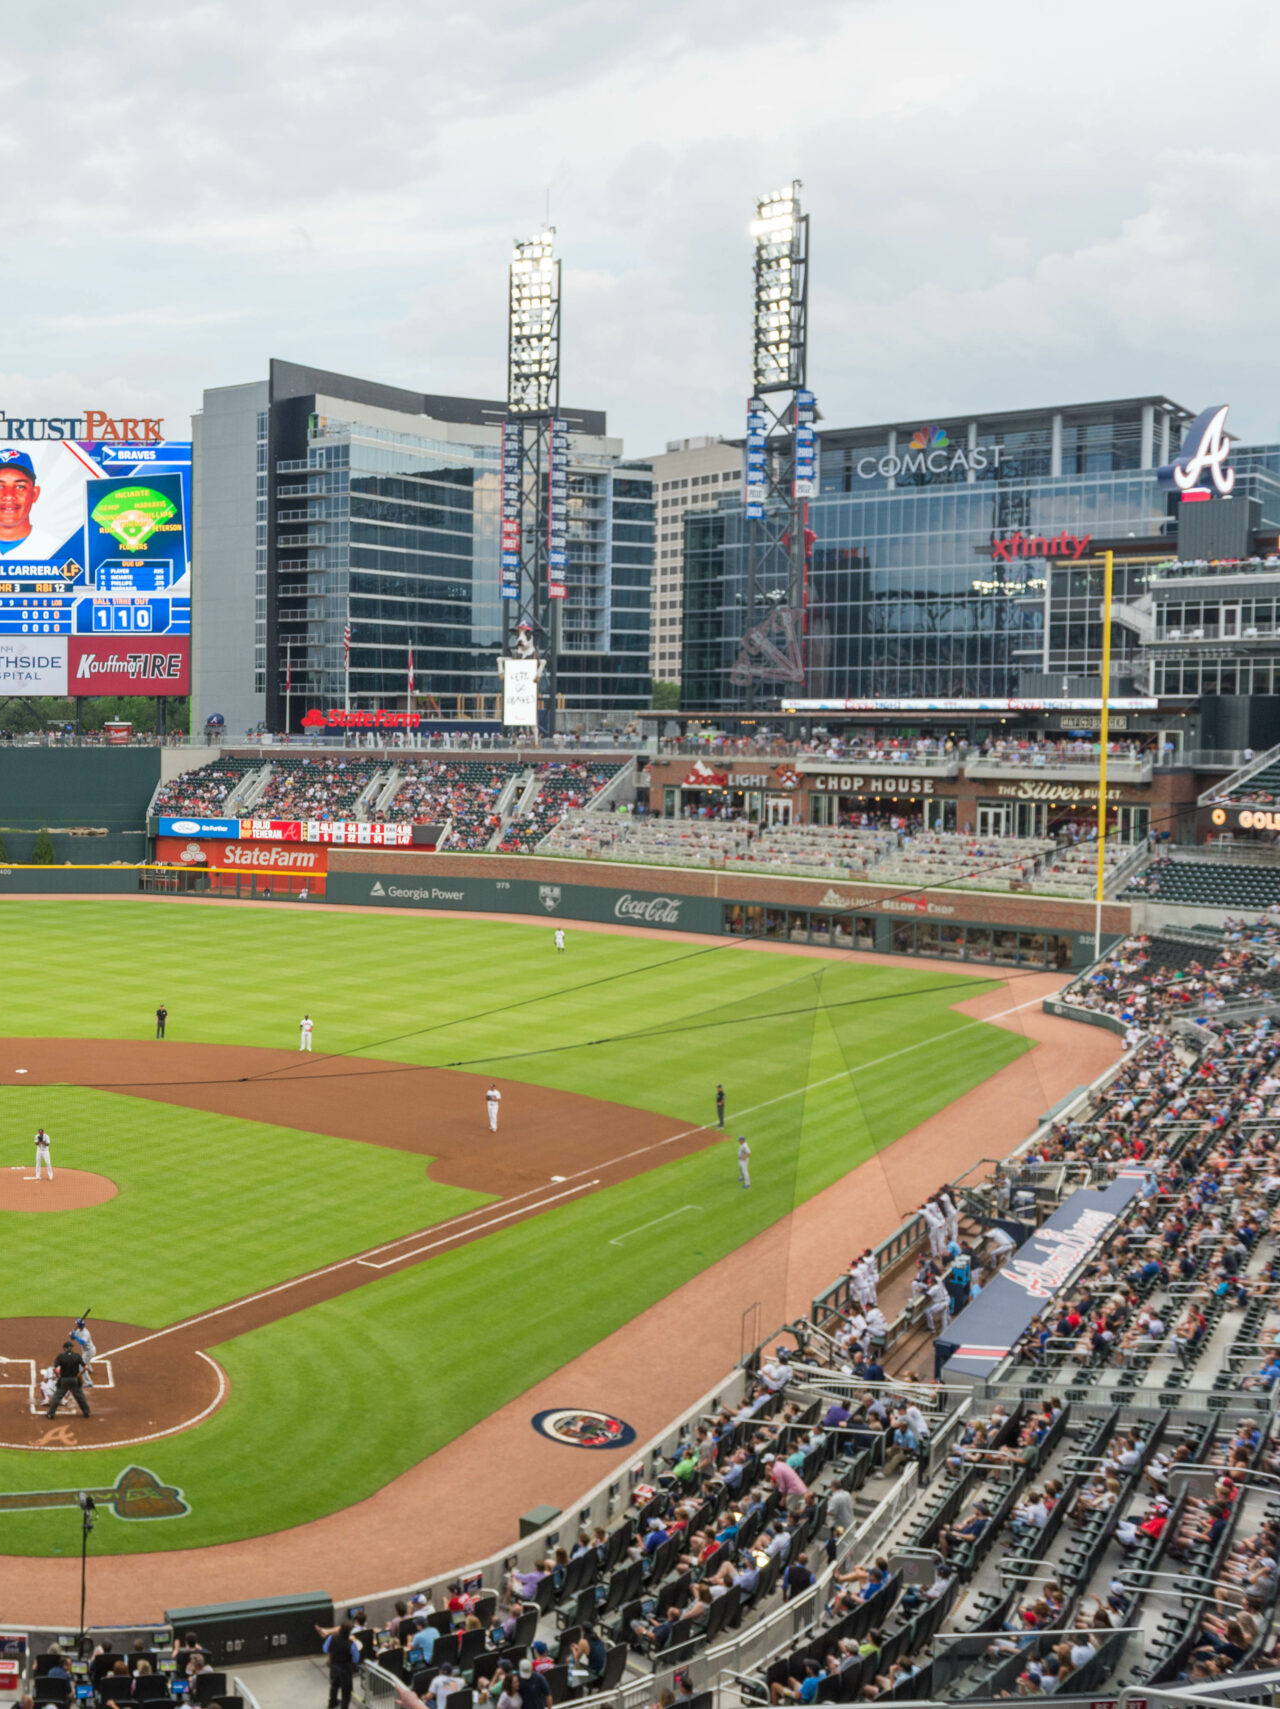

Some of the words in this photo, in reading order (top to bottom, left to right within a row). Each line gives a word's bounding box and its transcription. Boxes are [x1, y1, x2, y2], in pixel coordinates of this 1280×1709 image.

[118, 450, 156, 460] BRAVES
[856, 446, 1005, 479] COMCAST
[992, 531, 1092, 562] xfinity
[8, 565, 58, 576] CARRERA
[63, 564, 79, 576] LF
[14, 584, 20, 592] 3
[36, 584, 52, 592] RBI
[54, 584, 65, 592] 12
[97, 610, 107, 627] 1
[118, 610, 127, 627] 1
[136, 610, 149, 627] 0
[128, 654, 182, 678] TIRE
[728, 775, 768, 787] LIGHT
[815, 776, 864, 790] CHOP
[872, 778, 934, 794] HOUSE
[998, 786, 1016, 796] THE
[1017, 781, 1082, 800] Silver
[252, 820, 270, 830] JULIO
[347, 824, 356, 832] 44
[375, 824, 380, 833] 3
[252, 830, 283, 839] TEHERAN
[323, 833, 330, 842] 5
[347, 834, 356, 842] 22
[373, 835, 382, 843] 34
[397, 835, 410, 844] 1.47
[388, 886, 429, 899] Georgia
[432, 888, 464, 900] Power
[614, 894, 682, 924] Coca-Cola
[882, 899, 916, 912] BELOW
[927, 903, 954, 915] CHOP
